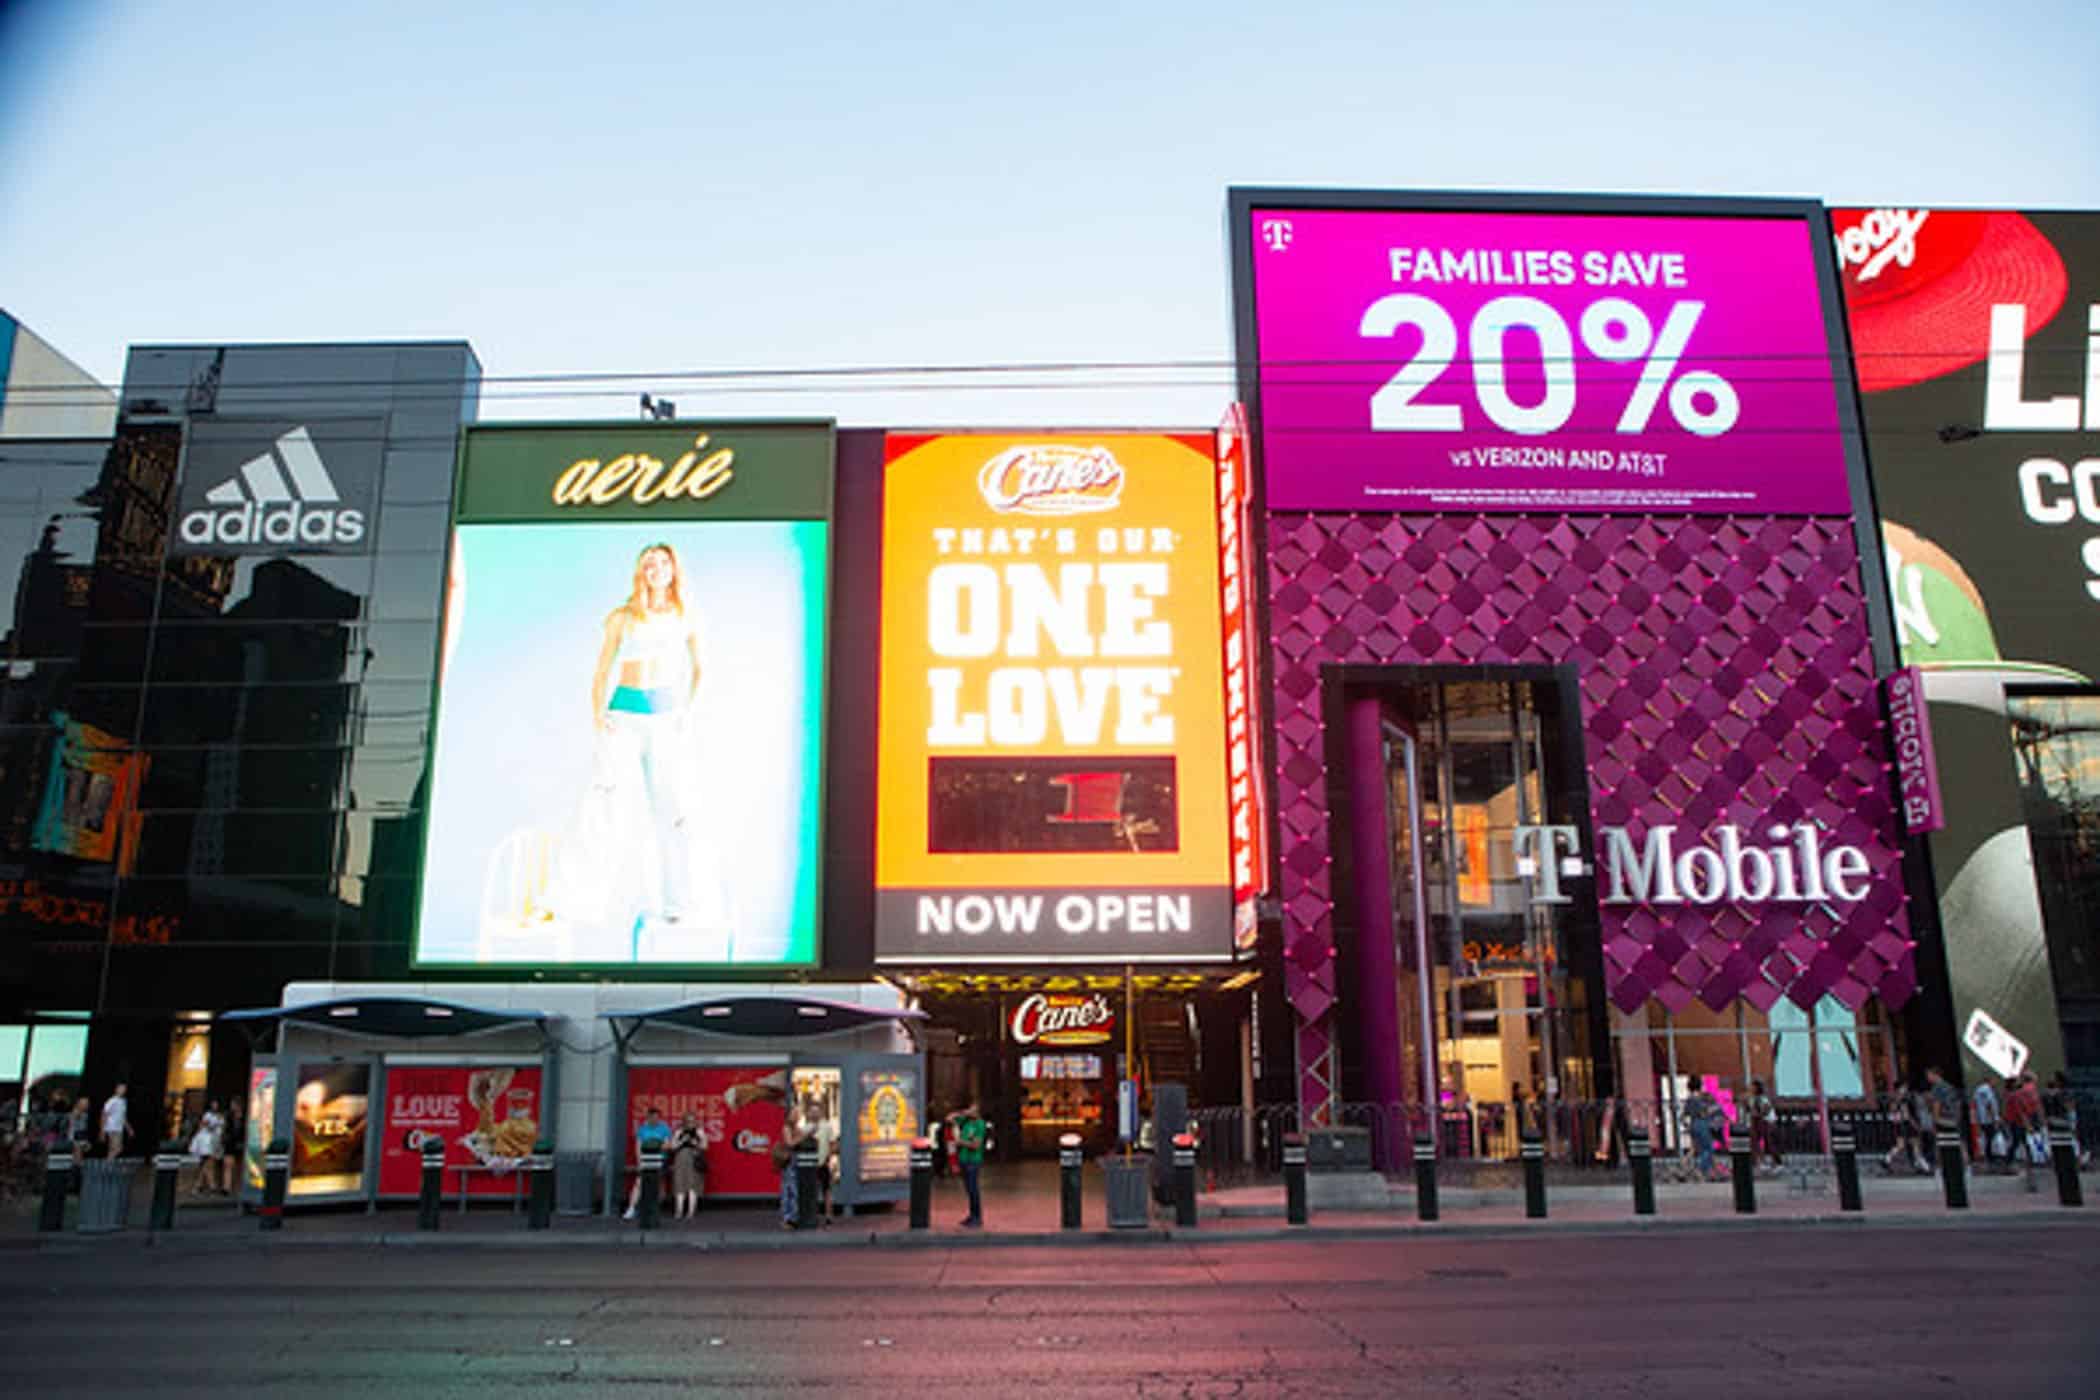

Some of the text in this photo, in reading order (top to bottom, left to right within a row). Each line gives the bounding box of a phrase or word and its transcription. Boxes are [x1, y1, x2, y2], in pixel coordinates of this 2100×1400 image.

[1389, 247, 1687, 288] FAMILIES SAVE
[1358, 292, 1741, 437] 20%
[552, 433, 735, 506] aerie
[986, 447, 1122, 509] Cane's
[1474, 448, 1564, 469] VERIZON
[1568, 451, 1614, 471] AND
[1617, 453, 1668, 476] AT&T
[180, 500, 365, 544] adidas
[933, 528, 1175, 554] THAT'S OUR
[928, 563, 1172, 657] ONE
[927, 667, 1176, 745] LOVE
[917, 896, 1191, 934] NOW OPEN
[1012, 993, 1114, 1044] Cane's
[391, 1095, 460, 1118] LOVE
